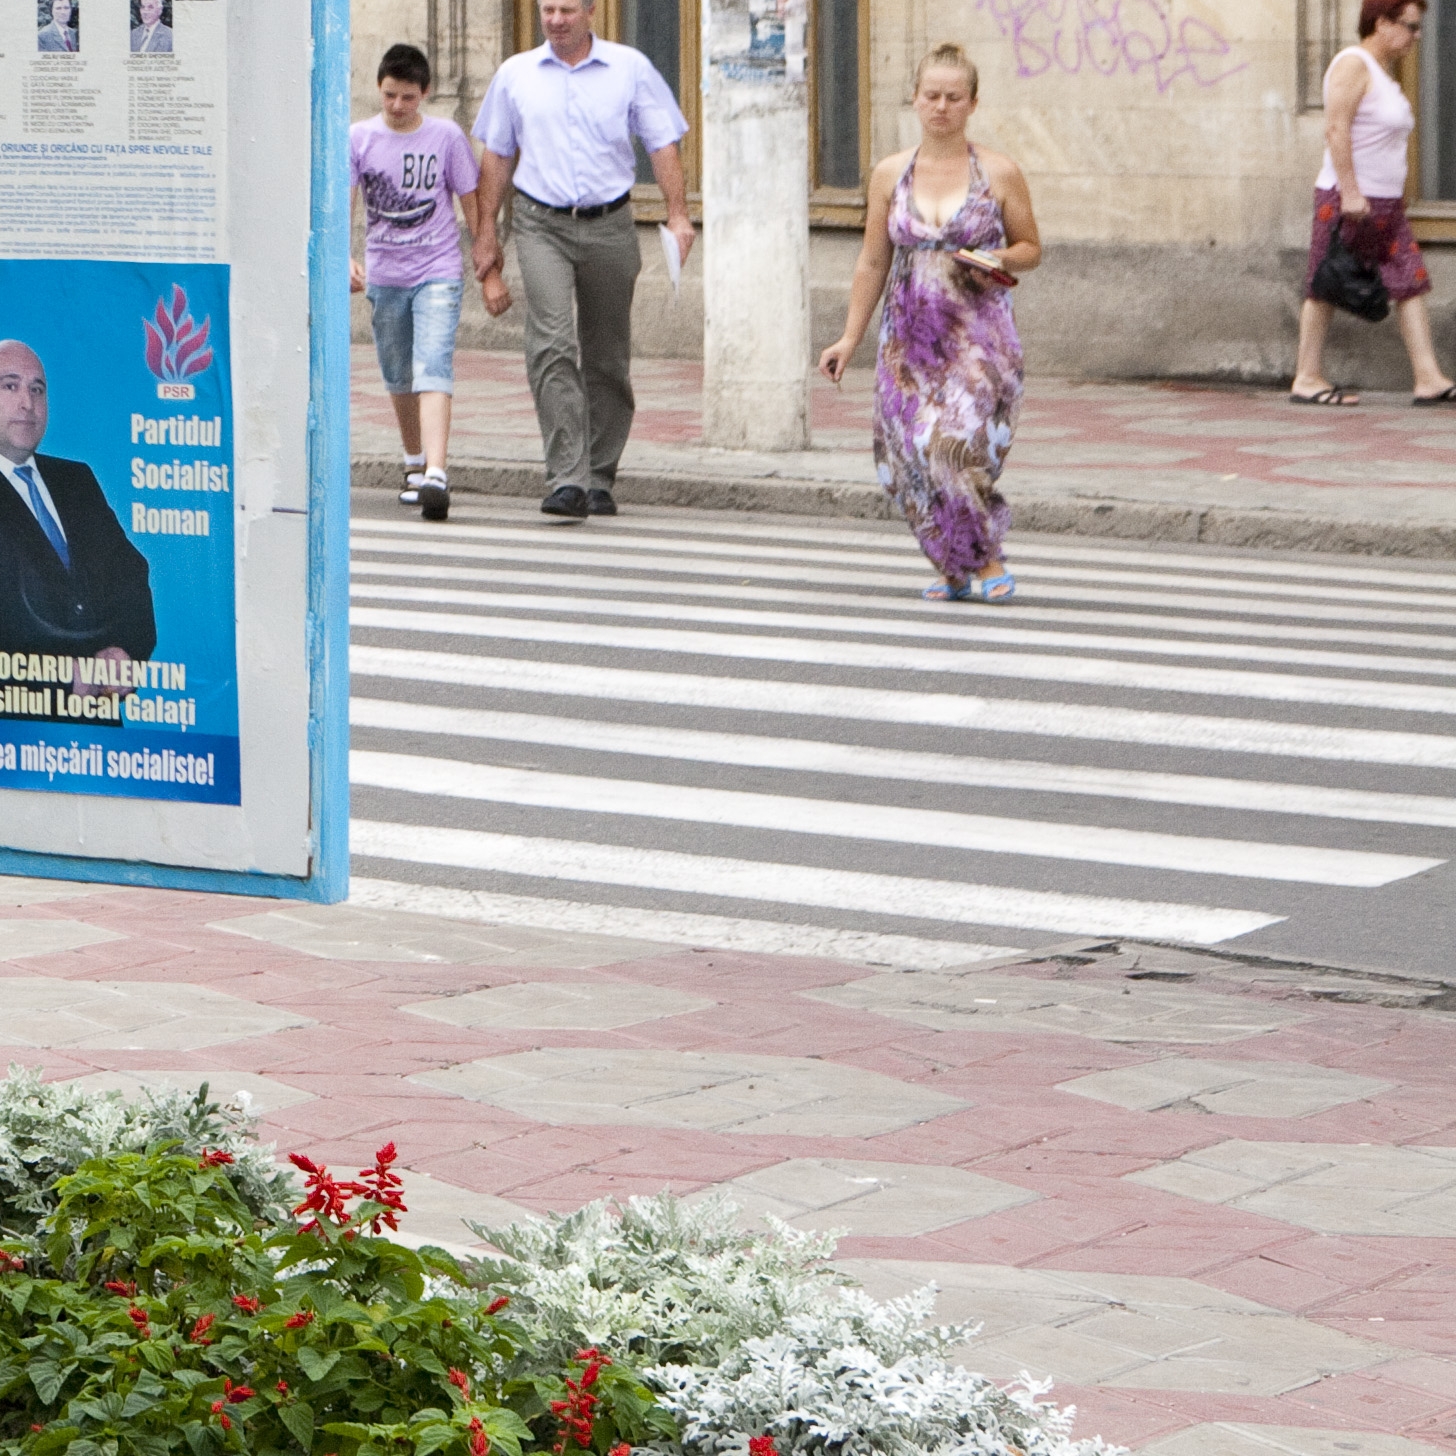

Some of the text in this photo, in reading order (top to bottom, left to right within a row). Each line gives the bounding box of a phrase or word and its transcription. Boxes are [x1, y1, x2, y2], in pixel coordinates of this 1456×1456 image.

[402, 153, 436, 190] BIG
[163, 386, 189, 398] PSR
[132, 414, 221, 447] Partidul
[132, 458, 229, 492] Socialist
[132, 503, 209, 536] Roman
[79, 657, 186, 691] VALENTIN
[57, 687, 119, 720] Local
[125, 694, 195, 732] Galați
[21, 742, 104, 782] mișcării
[107, 750, 215, 785] socialiste!
